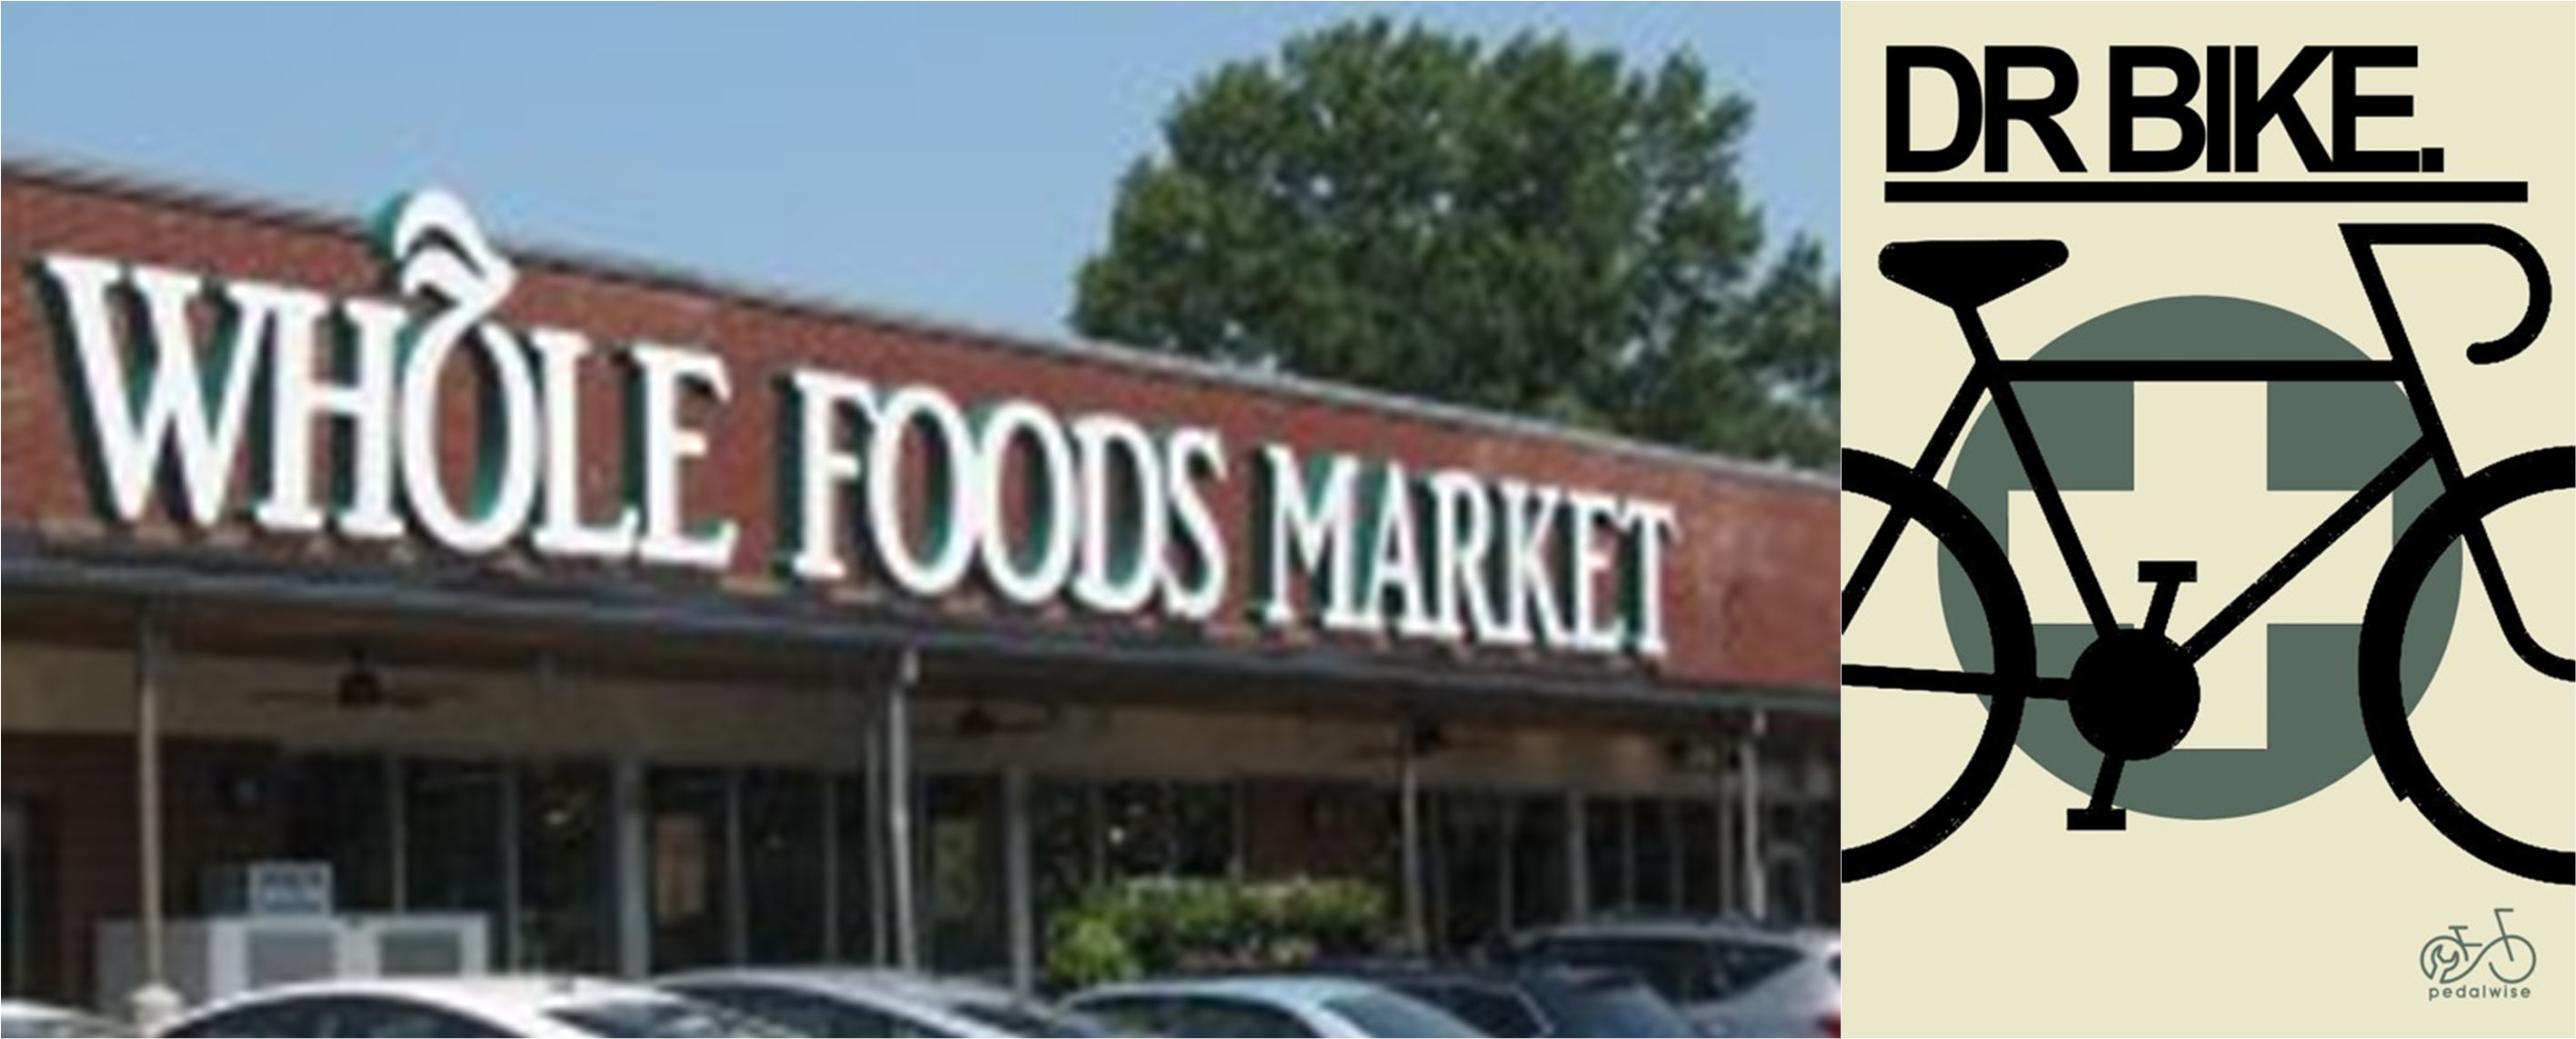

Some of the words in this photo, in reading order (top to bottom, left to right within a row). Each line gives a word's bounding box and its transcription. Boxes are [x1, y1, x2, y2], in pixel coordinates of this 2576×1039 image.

[1885, 45, 2088, 173] DR
[2109, 45, 2444, 173] BIKE.
[44, 187, 738, 567] WHOLE
[791, 369, 1228, 620] FOODS
[1263, 444, 1678, 656] MARKET
[2428, 984, 2531, 1002] pedalwise
